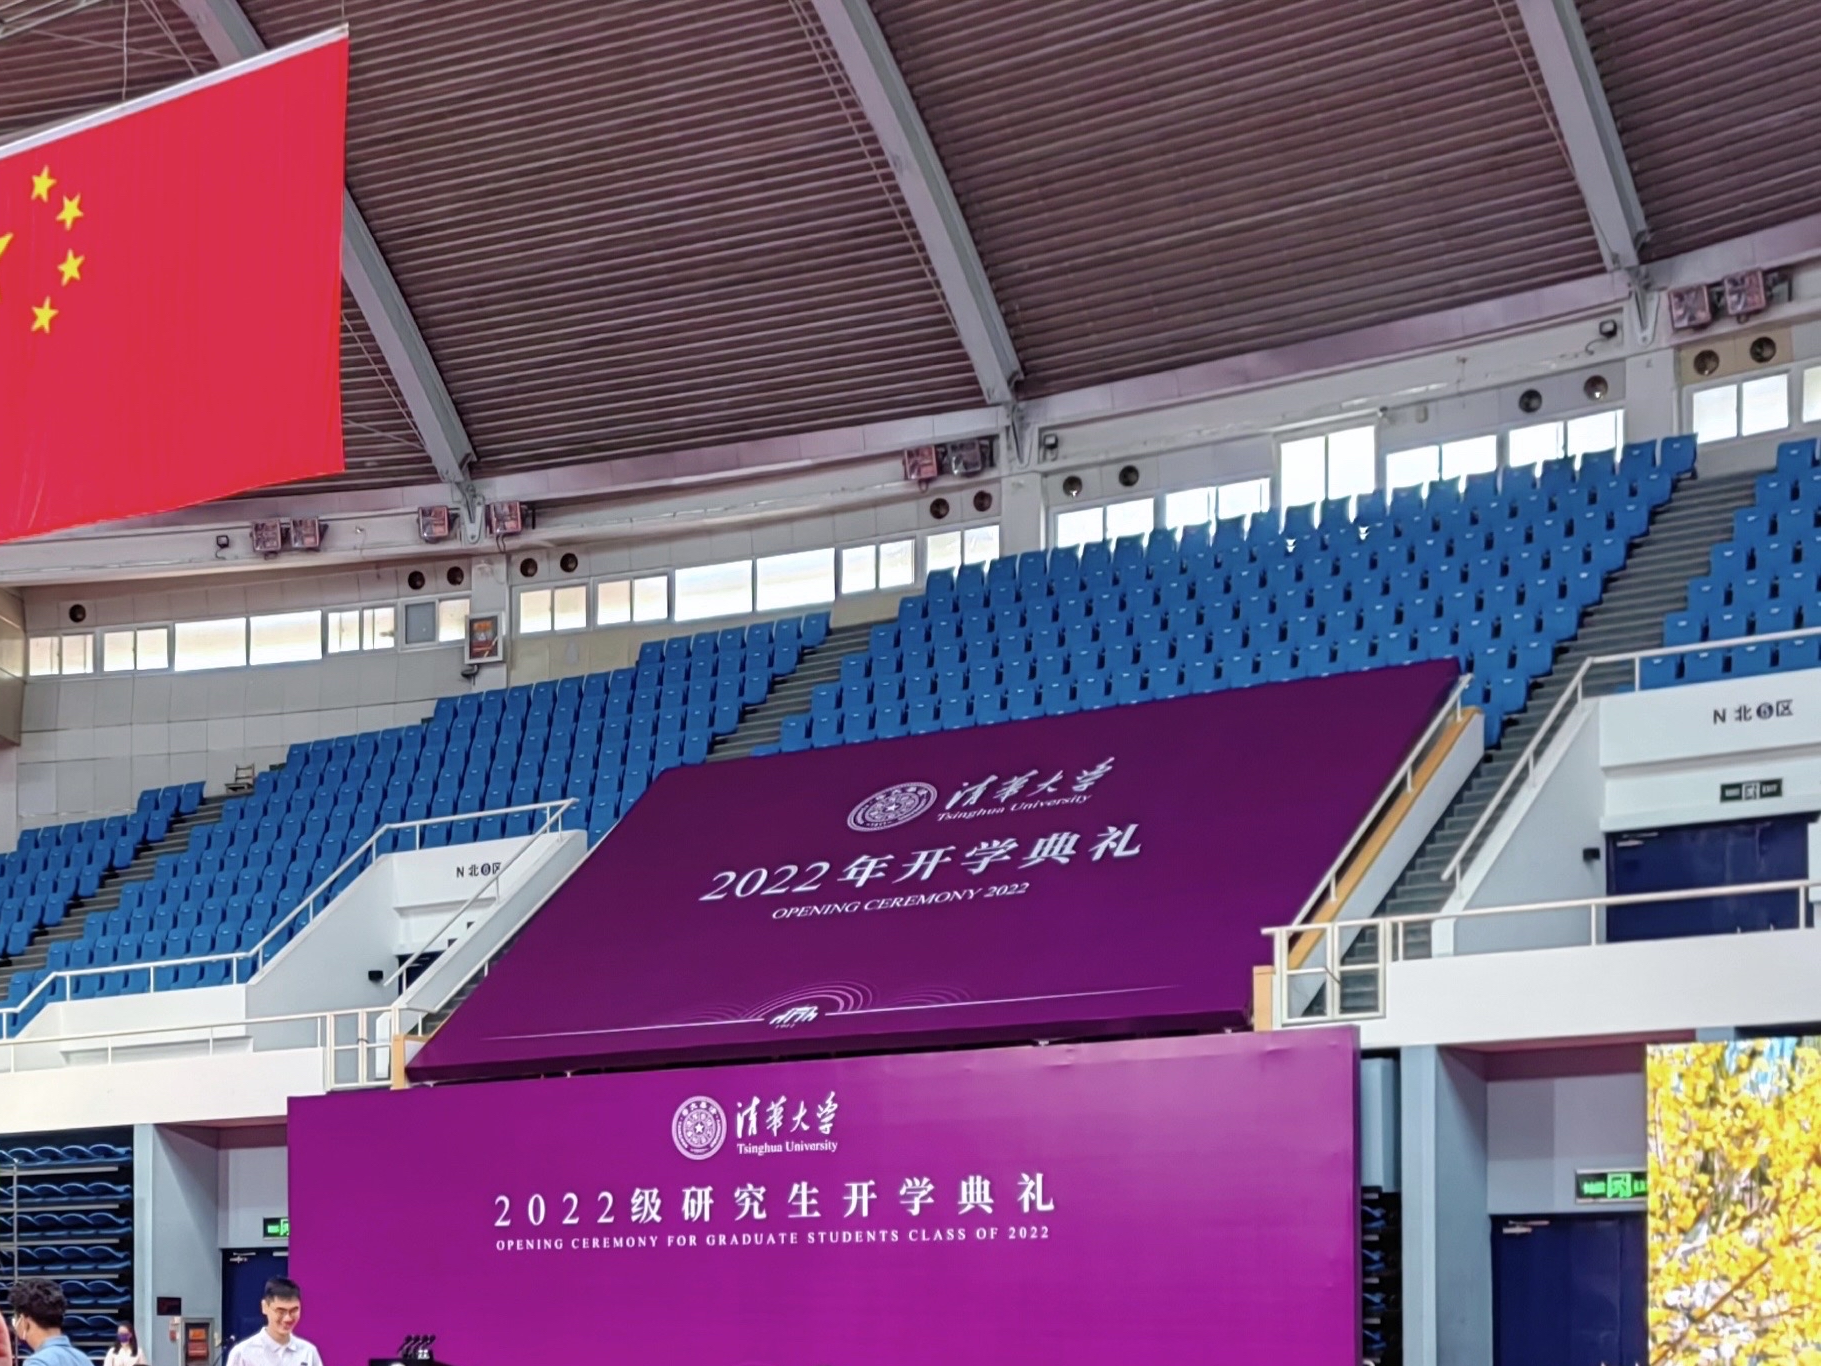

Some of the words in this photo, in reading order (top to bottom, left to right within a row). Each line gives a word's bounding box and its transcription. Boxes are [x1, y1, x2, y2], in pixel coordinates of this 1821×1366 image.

[937, 806, 1006, 822] Tsinghua
[1010, 794, 1092, 812] University
[771, 901, 862, 920] OPENING
[864, 887, 983, 911] CEREMONY
[983, 881, 1031, 898] 2022
[736, 1141, 783, 1156] Tsinghua
[785, 1138, 838, 1153] University
[495, 1238, 564, 1251] OPENING
[571, 1235, 658, 1249] CEREMONY
[667, 1234, 697, 1247] FOR
[706, 1231, 798, 1246] GRADUATE
[807, 1229, 899, 1243] STUDENTS
[908, 1228, 966, 1242] CLASS
[976, 1227, 999, 1240] OF
[1008, 1225, 1049, 1240] 2022
